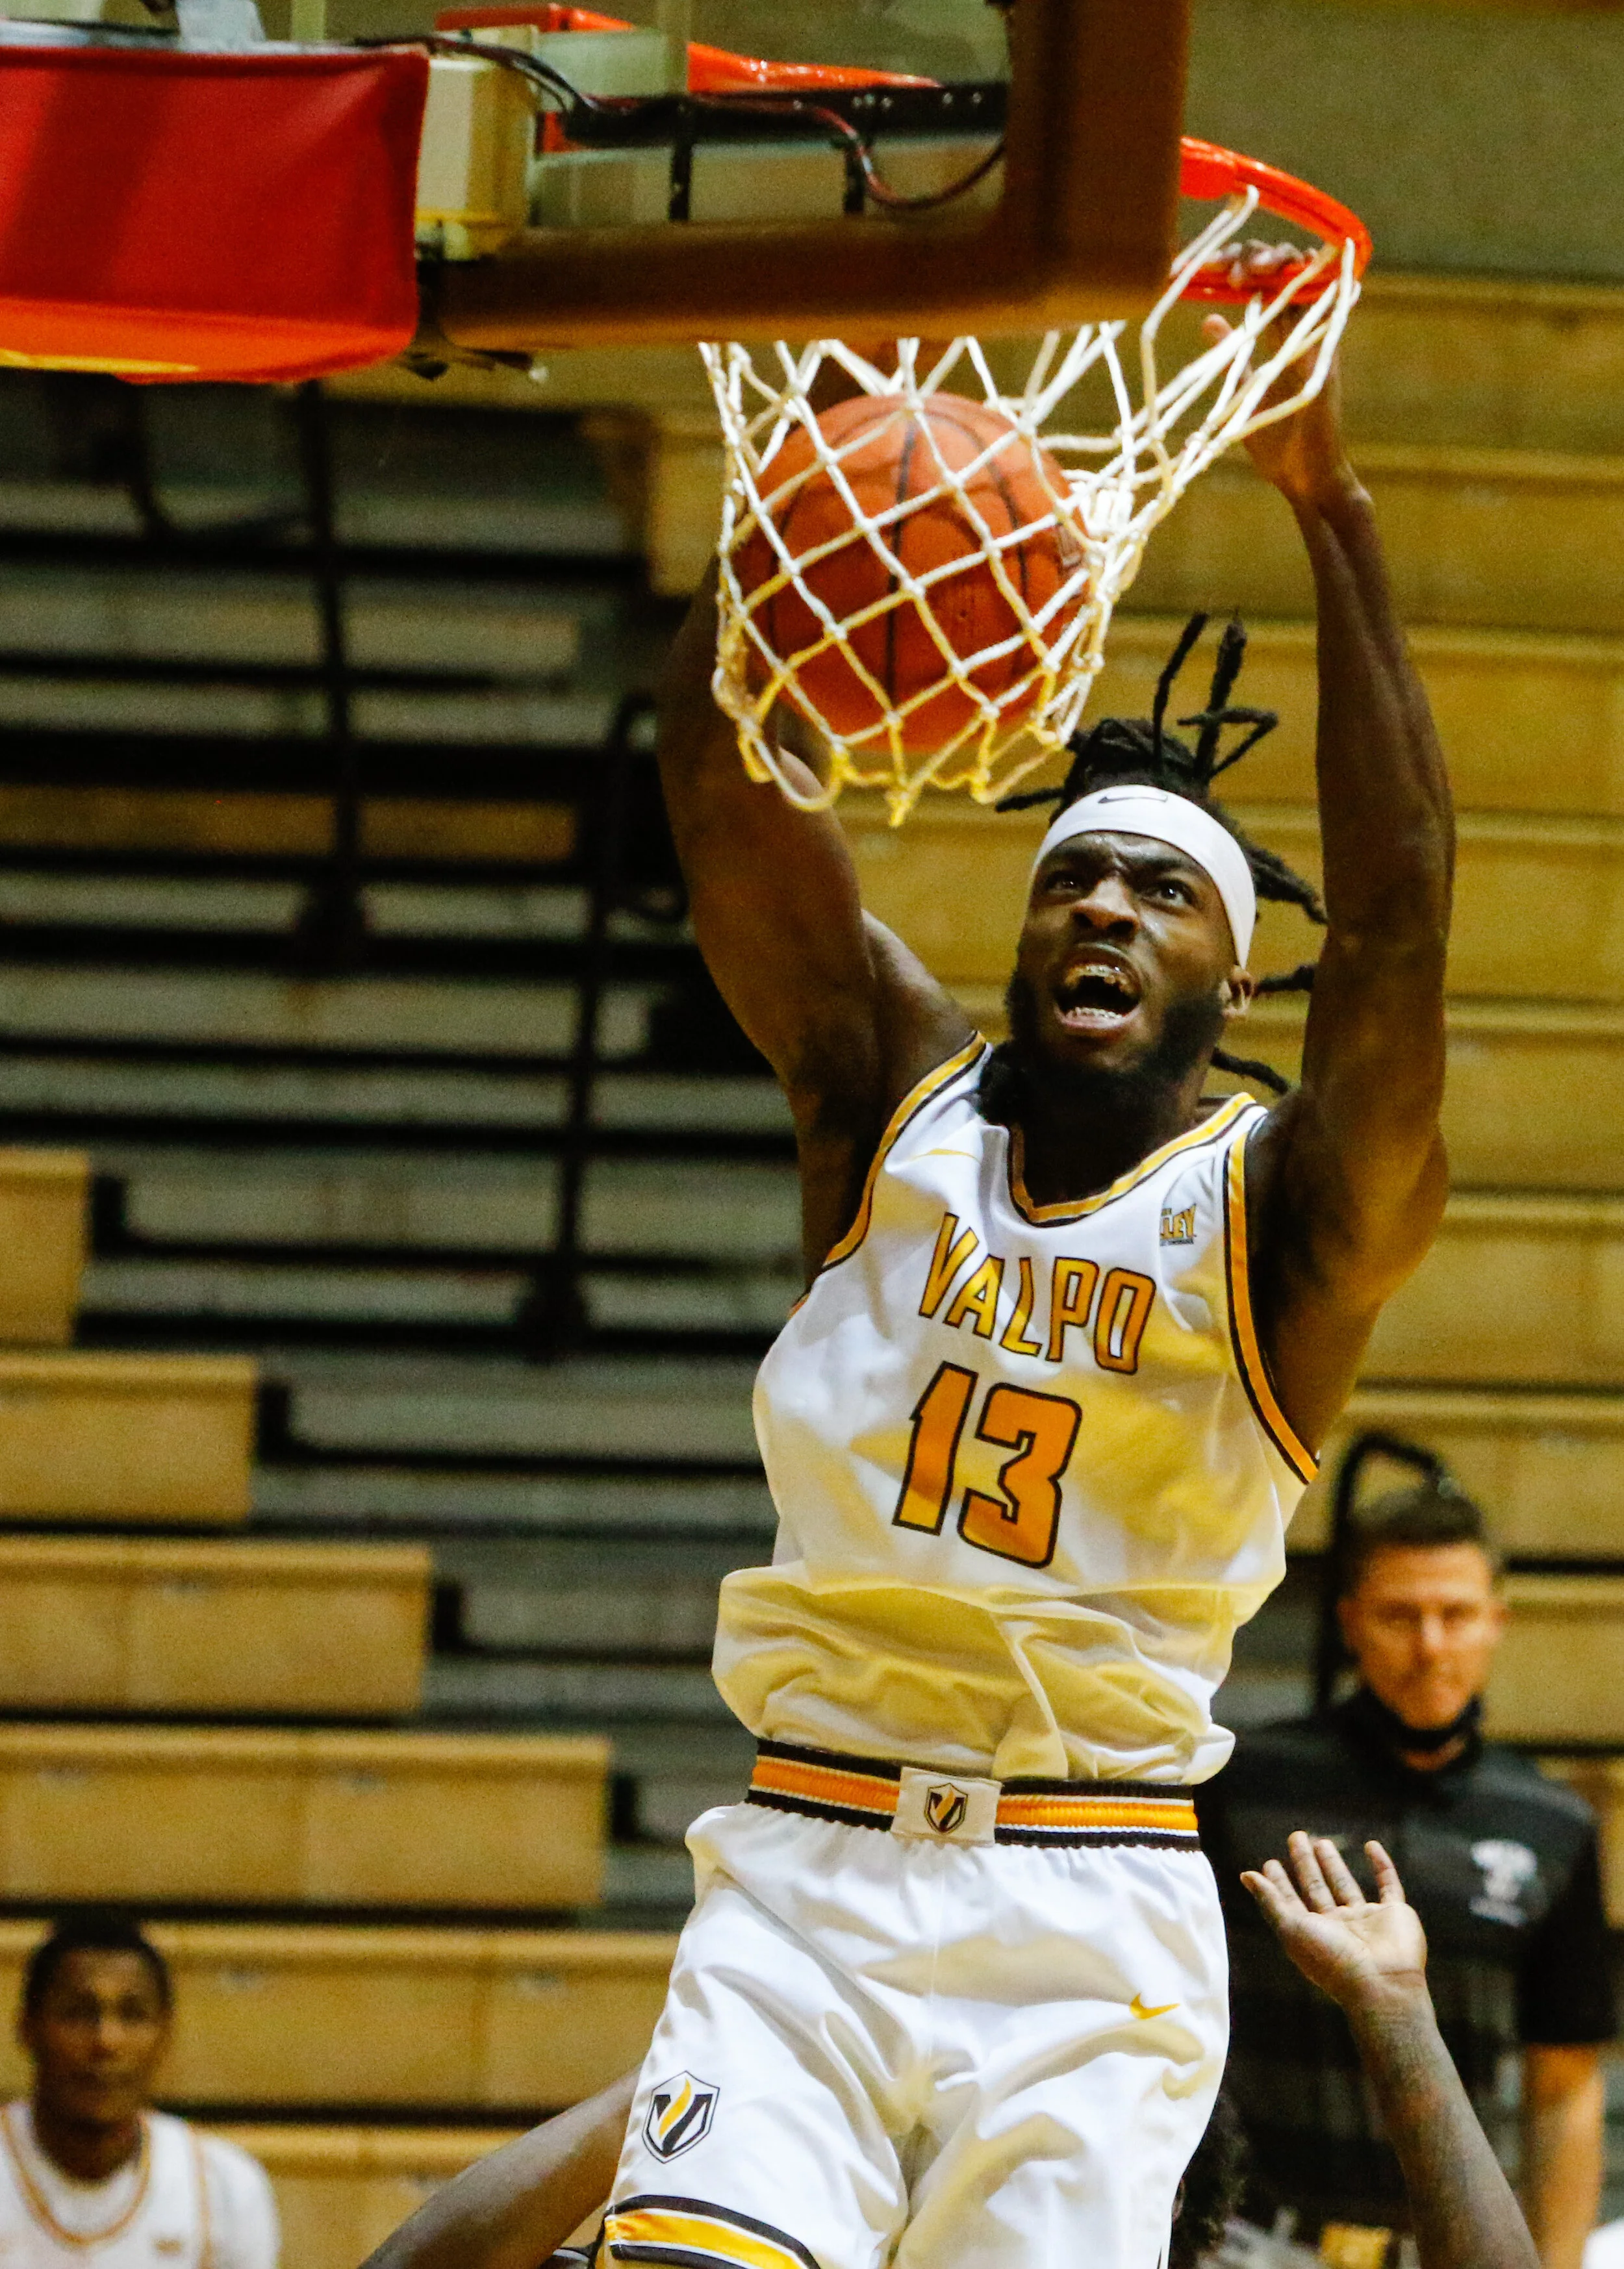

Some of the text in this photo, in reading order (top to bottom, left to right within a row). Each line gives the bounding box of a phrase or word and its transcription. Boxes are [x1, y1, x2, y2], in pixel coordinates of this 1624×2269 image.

[918, 1211, 1156, 1375] VALPO
[1160, 1203, 1197, 1240] LEY
[892, 1360, 1082, 1569] 13
